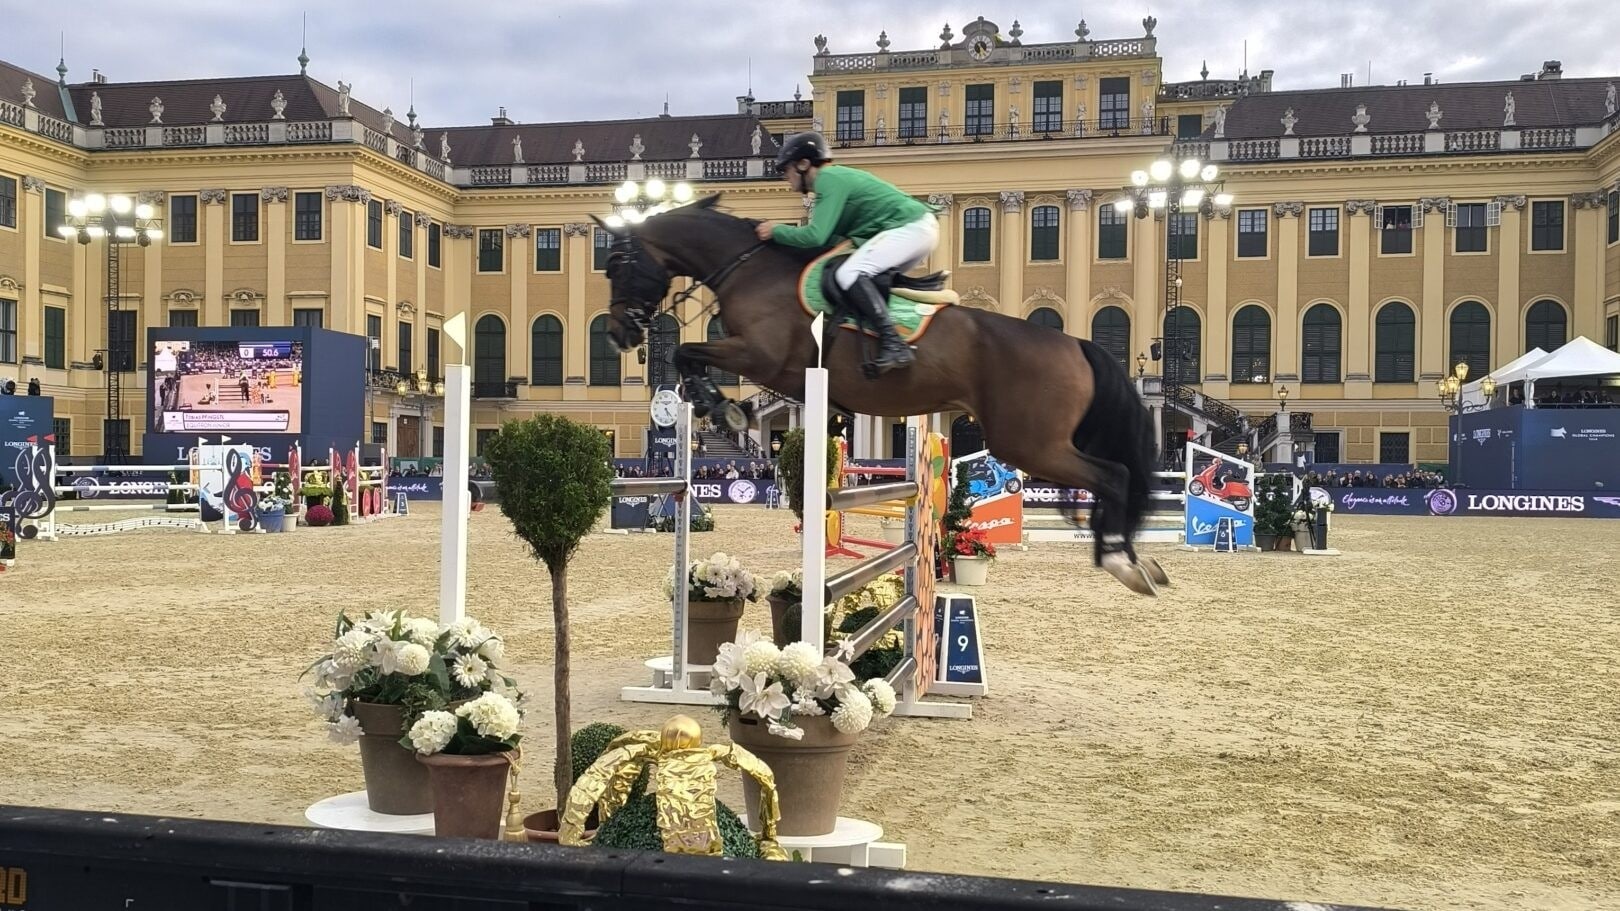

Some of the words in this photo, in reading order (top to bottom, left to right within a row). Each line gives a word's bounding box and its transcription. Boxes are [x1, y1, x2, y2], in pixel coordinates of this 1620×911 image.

[109, 481, 191, 495] LONGINS
[1467, 494, 1585, 511] LONGINES
[957, 635, 969, 652] 9
